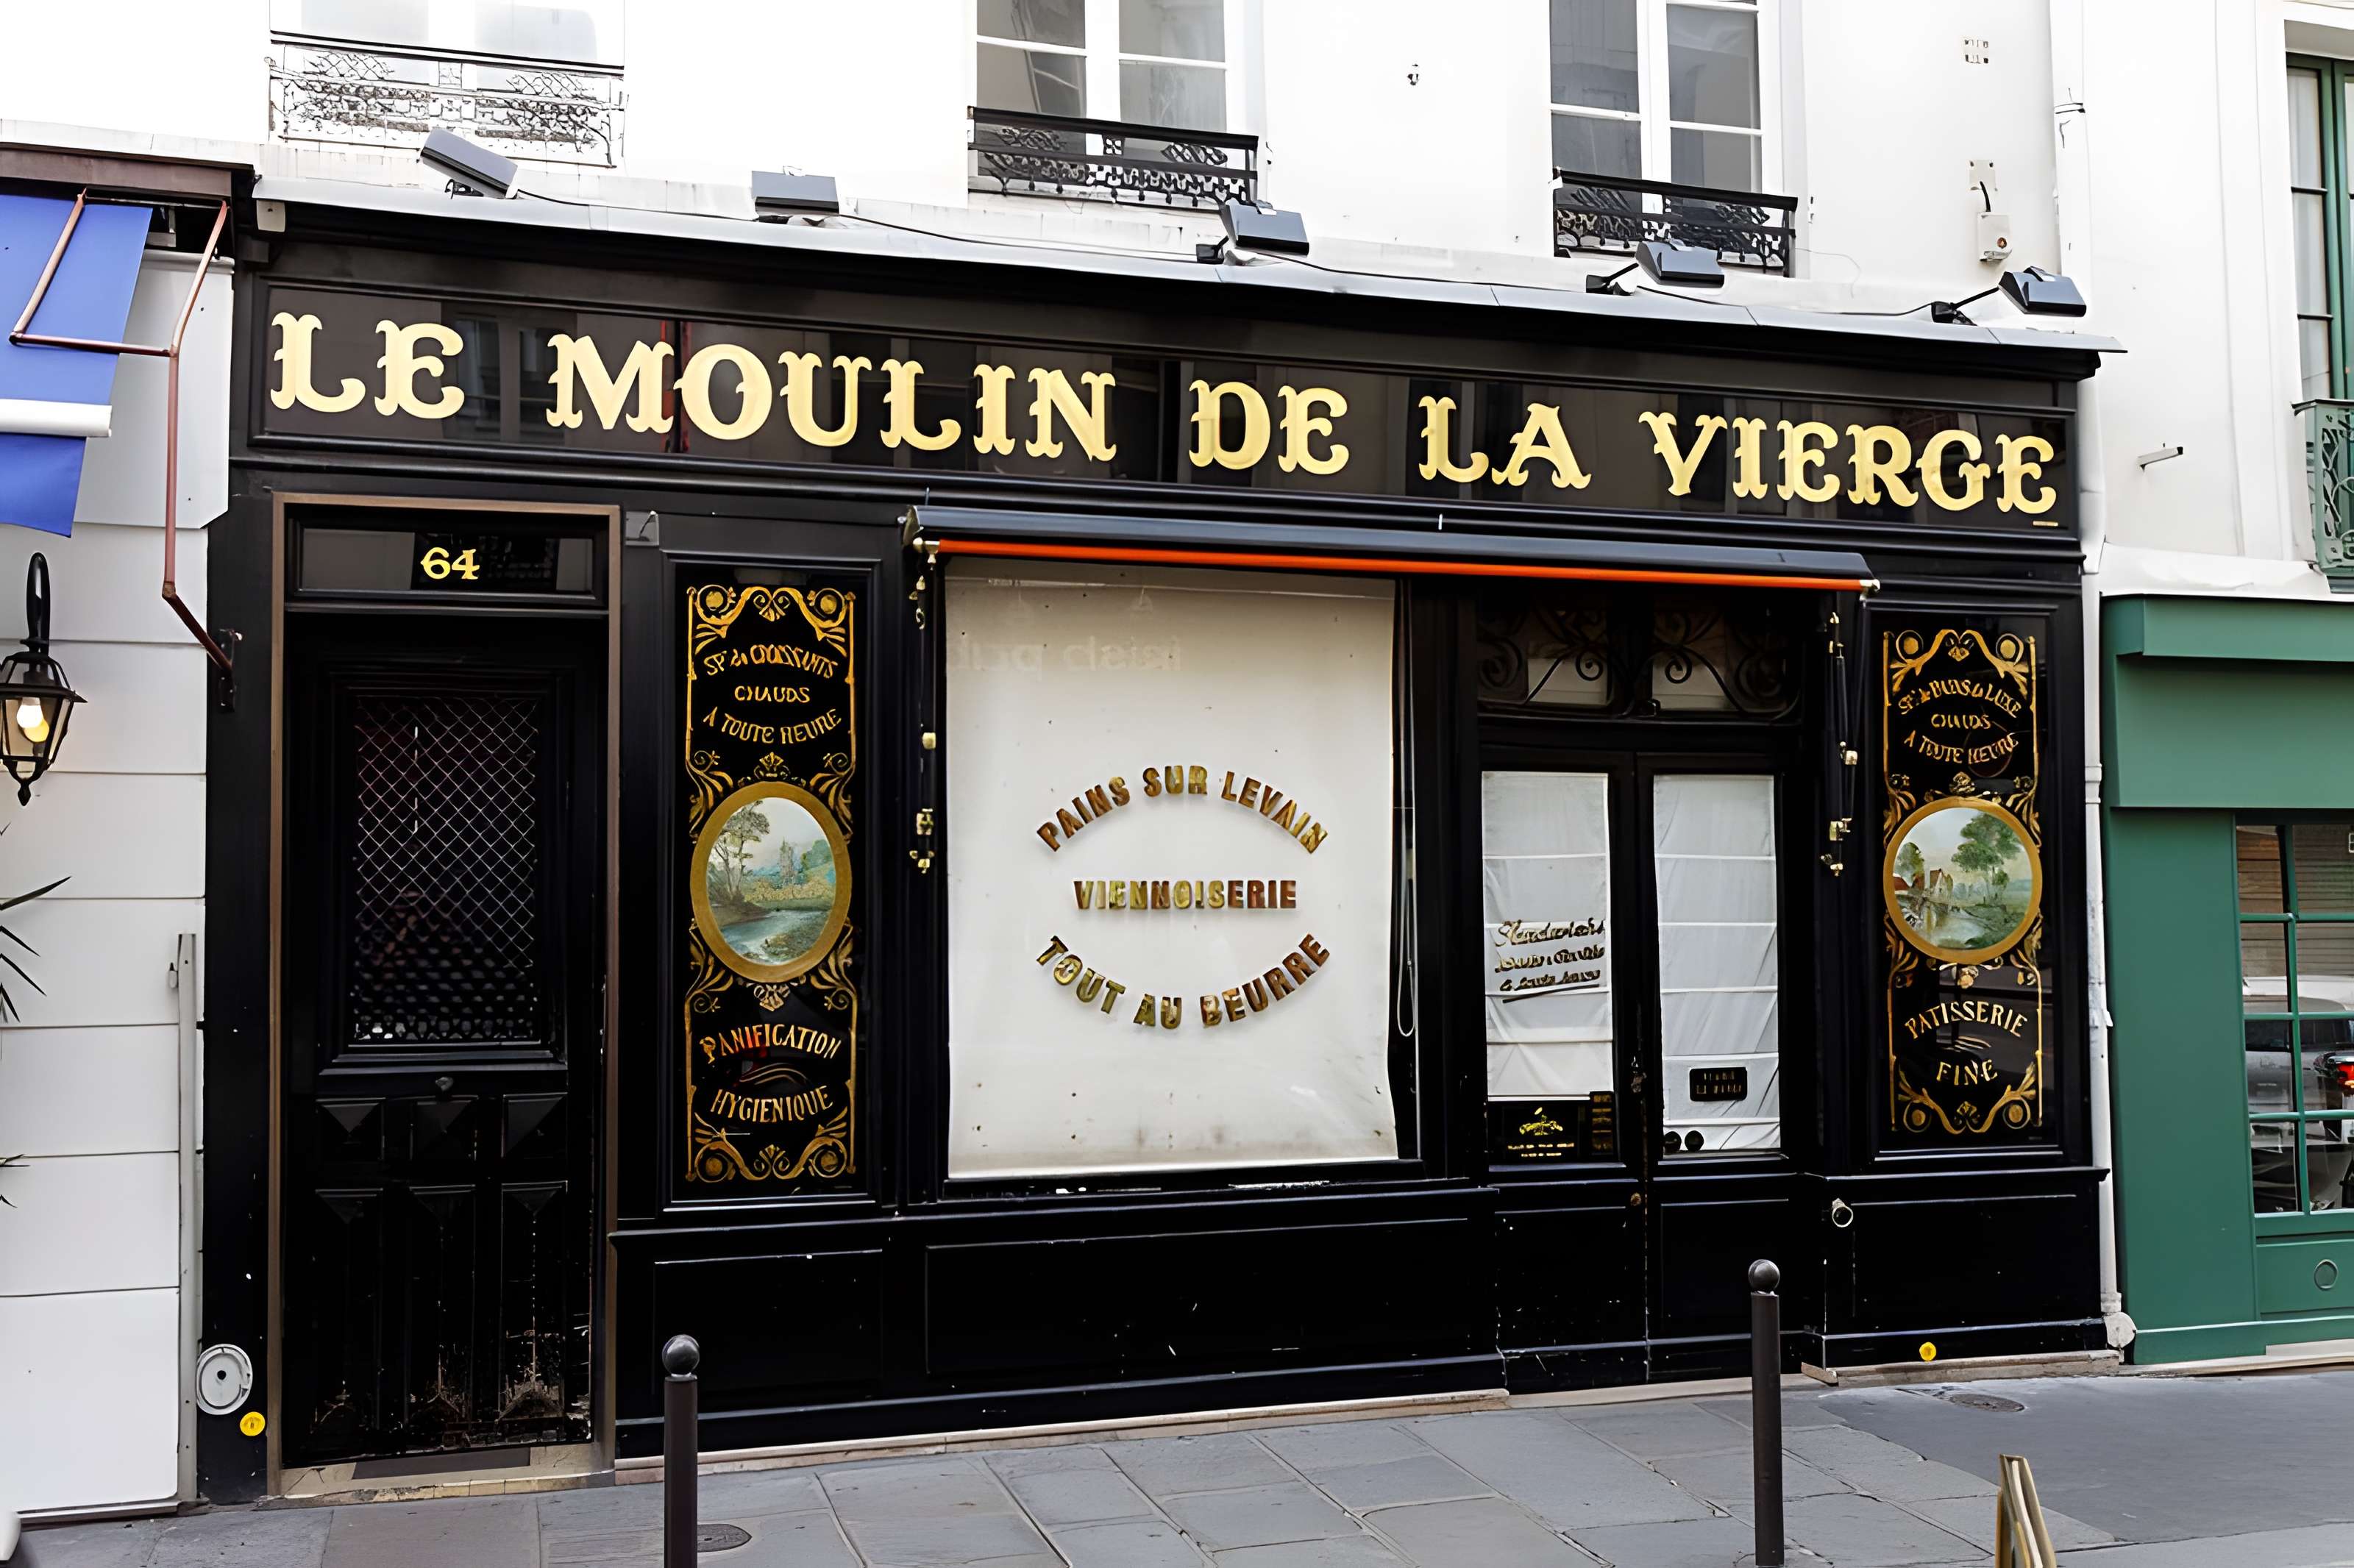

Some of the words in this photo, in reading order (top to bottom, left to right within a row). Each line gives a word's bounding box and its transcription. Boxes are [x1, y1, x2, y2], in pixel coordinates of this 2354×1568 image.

[270, 312, 466, 420] LE
[545, 333, 1117, 463] MOULIN
[1188, 379, 1350, 475] DE
[1418, 395, 1593, 490] LA
[1638, 410, 2058, 515] VIERGE
[419, 546, 480, 580] 64
[721, 713, 775, 744] TOUTE
[1036, 776, 1131, 852] PAINS
[1142, 764, 1209, 798] SUR
[1220, 770, 1329, 855] LEVAIN
[1073, 880, 1297, 910] VIENNOISERIE
[1036, 935, 1127, 1015] TOUT
[1132, 993, 1183, 1030] AU
[1199, 933, 1331, 1029] BEURRE
[1904, 1000, 2028, 1040] PATISSERIE
[699, 1023, 842, 1065] PANIFICATION
[1935, 1058, 1998, 1086] FINE
[710, 1085, 833, 1123] HYGIENIQUE
